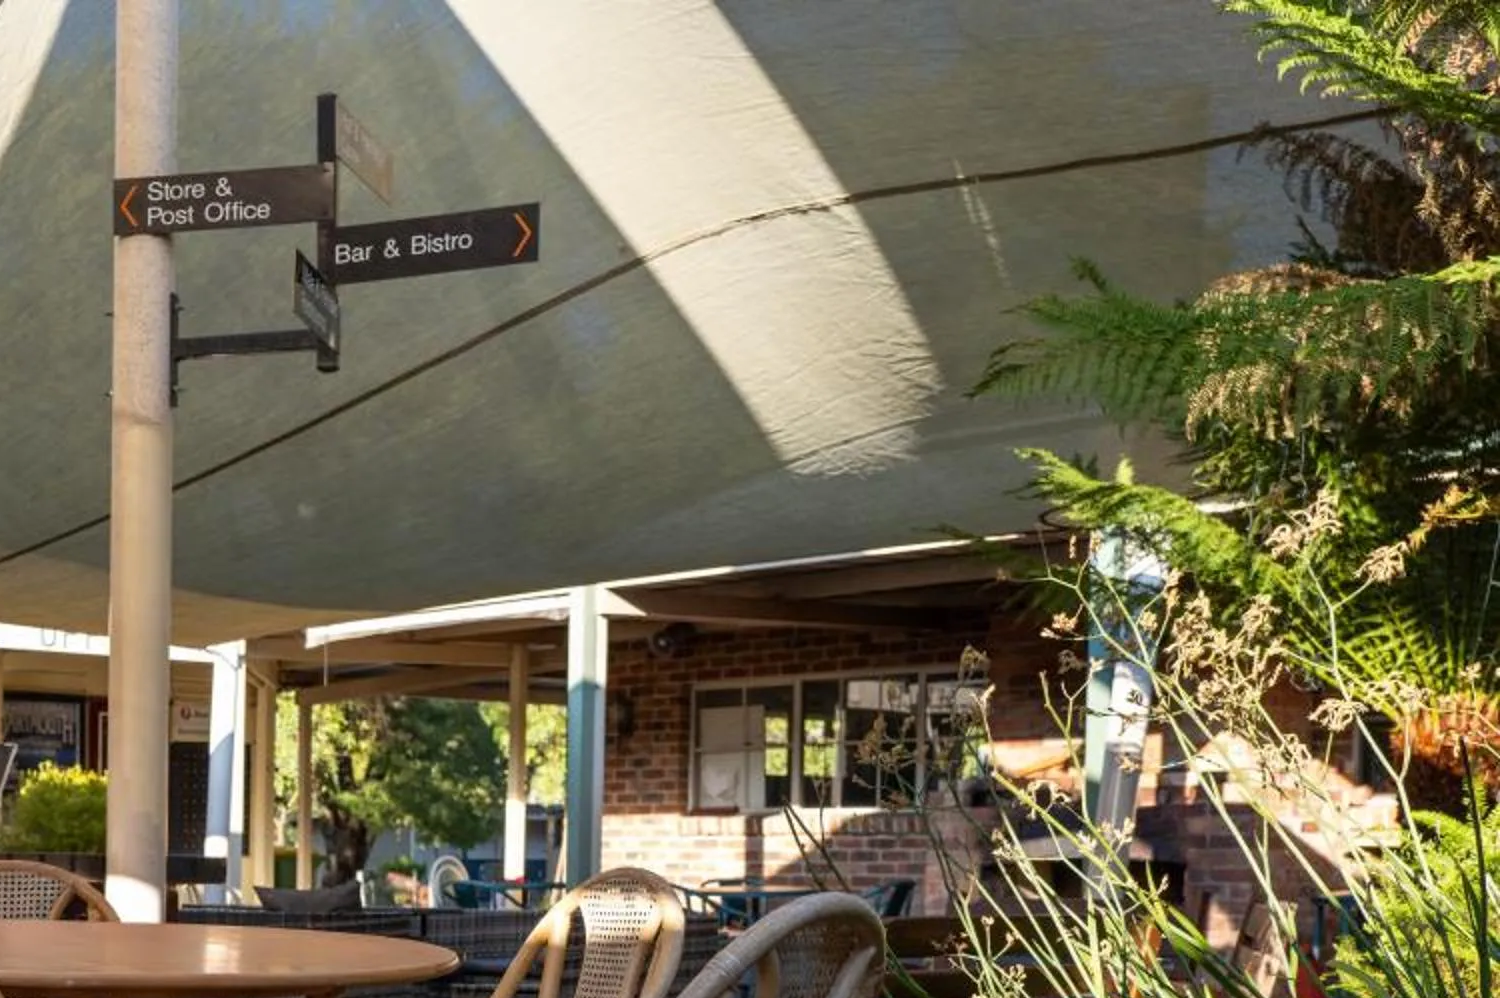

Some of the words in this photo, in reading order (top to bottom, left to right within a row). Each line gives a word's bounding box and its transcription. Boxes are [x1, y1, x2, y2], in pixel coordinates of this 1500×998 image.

[147, 181, 205, 202] Store
[215, 177, 233, 197] &
[147, 205, 195, 227] Post
[204, 201, 272, 223] Office
[335, 243, 373, 265] Bar
[383, 237, 401, 259] &
[411, 232, 474, 255] Bistro
